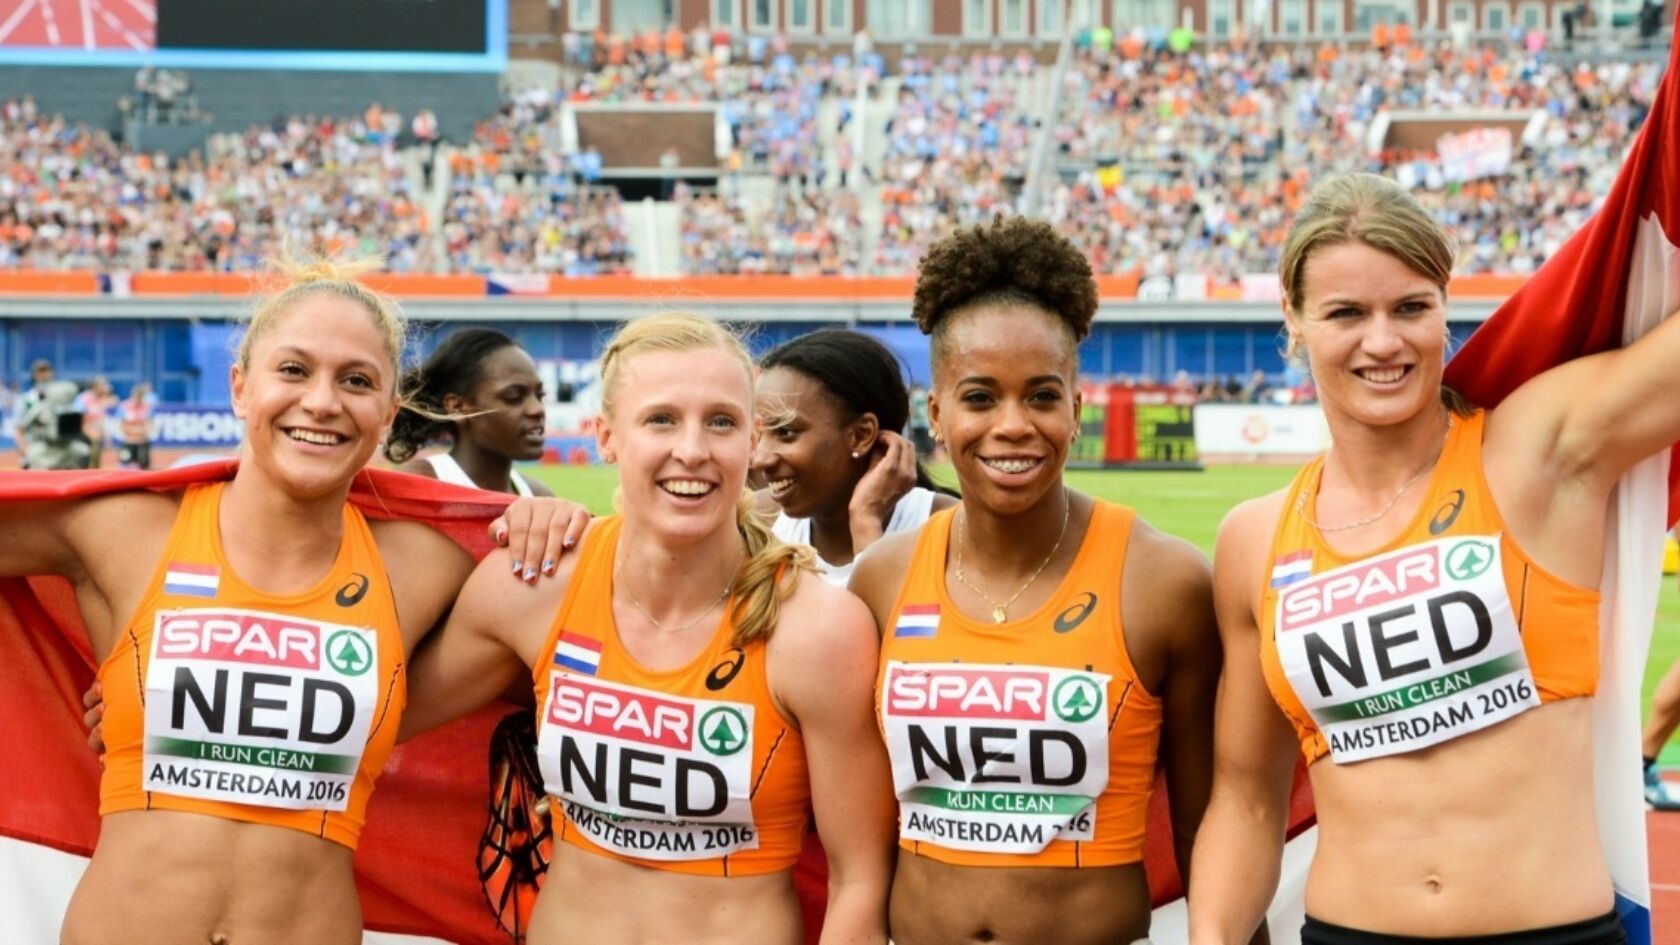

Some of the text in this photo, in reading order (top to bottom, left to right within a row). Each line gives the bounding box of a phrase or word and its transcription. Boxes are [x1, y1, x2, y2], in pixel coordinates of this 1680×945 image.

[1285, 553, 1435, 624] SPAR
[161, 619, 316, 664] SPAR
[1303, 590, 1493, 698] NED
[170, 666, 355, 745] NED
[552, 687, 689, 744] SPAR
[891, 675, 1043, 714] SPAR
[1331, 679, 1531, 753] AMSTERDAM 2016
[1356, 672, 1472, 717] I RUN CLEAN
[200, 743, 315, 770] I RUN CLEAN
[560, 734, 728, 817] NED
[907, 724, 1087, 787] NED
[150, 763, 346, 801] AMSTERDAM 2016
[992, 794, 1054, 812] CLEAN
[566, 804, 696, 852] AMSTERDAM
[702, 827, 753, 850] 2016
[907, 812, 1043, 844] AMSTERDAM
